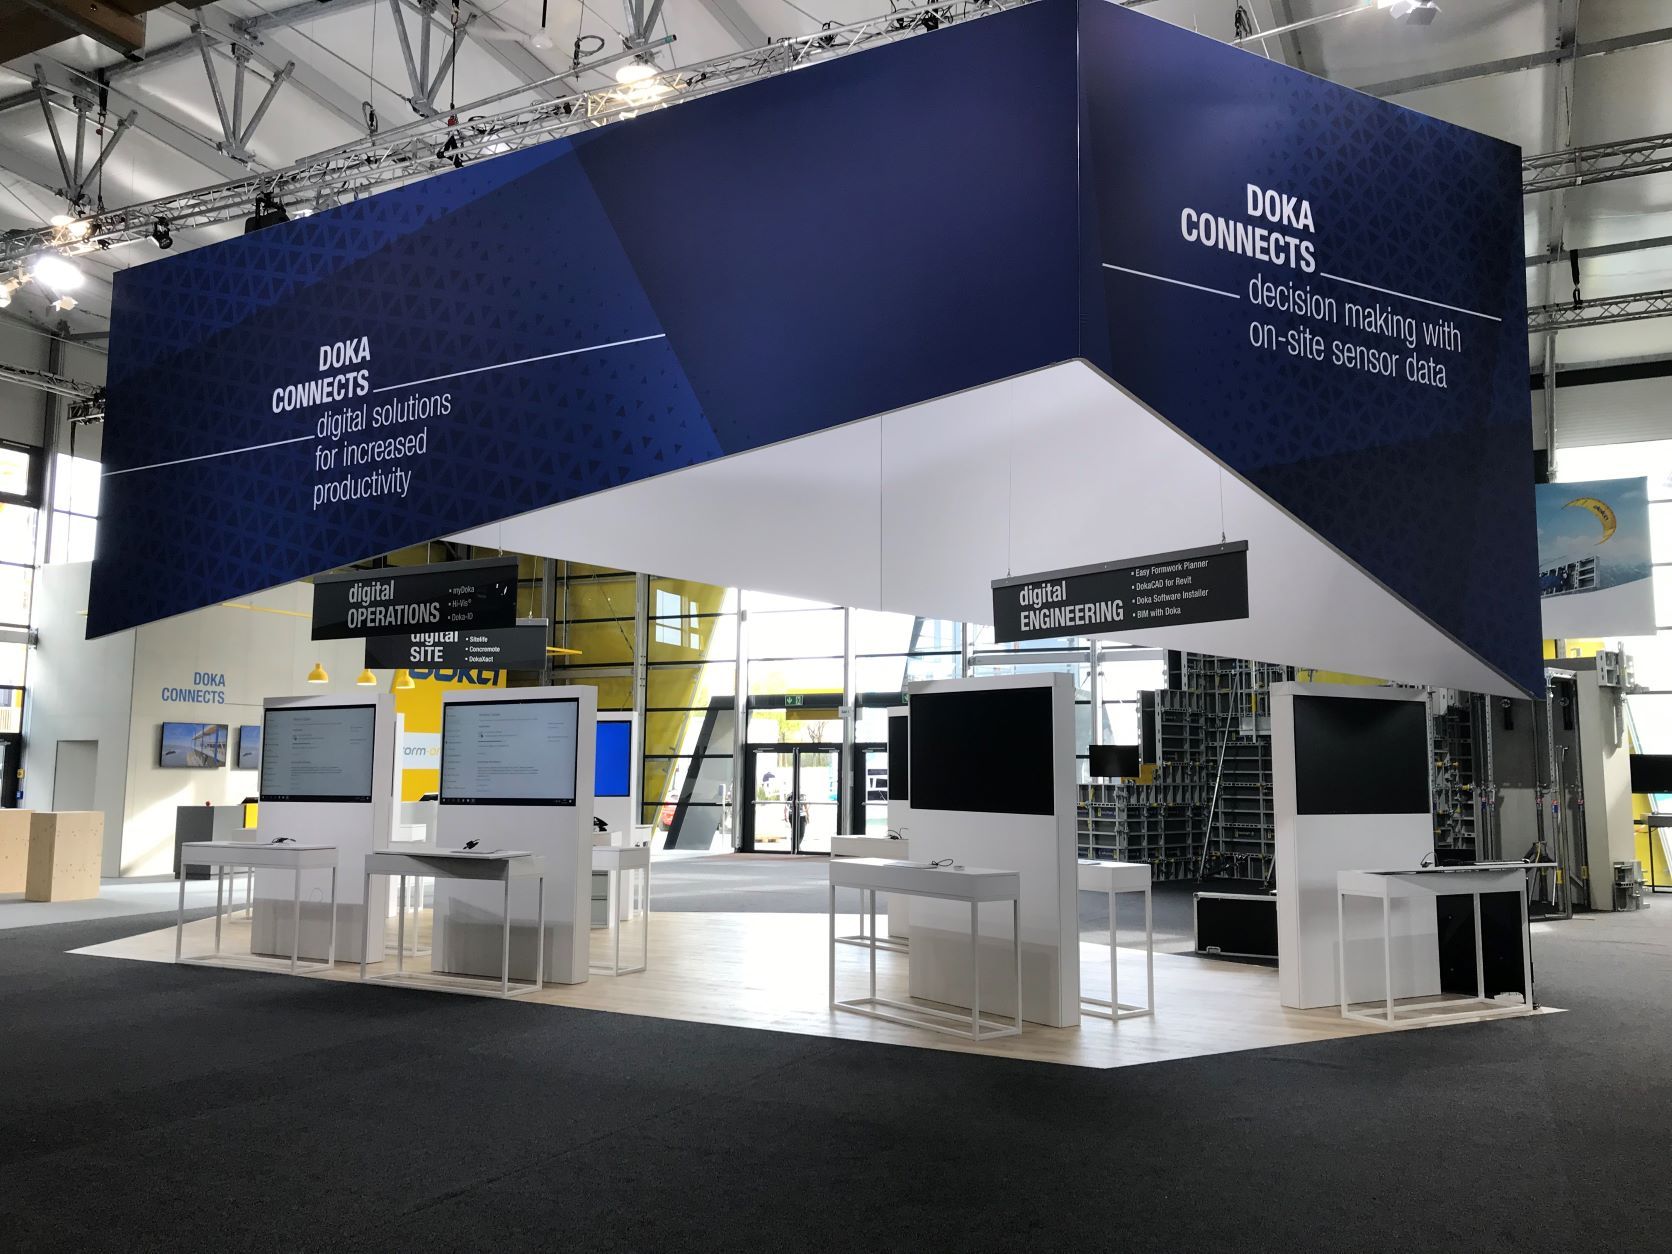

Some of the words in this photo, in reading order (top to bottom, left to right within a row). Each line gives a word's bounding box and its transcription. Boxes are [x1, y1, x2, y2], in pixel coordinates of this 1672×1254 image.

[1246, 183, 1315, 233] DOKA
[1181, 207, 1316, 273] CONNECTS
[1249, 273, 1337, 323] decision
[1345, 303, 1416, 348] making
[1423, 319, 1461, 352] with
[319, 336, 371, 371] DOKA
[1250, 321, 1325, 360] on-site
[1332, 340, 1399, 377] sensor
[1406, 352, 1448, 388] data
[272, 369, 369, 413] CONNECTS
[317, 403, 367, 440] digital
[372, 393, 451, 427] solutions
[315, 445, 338, 471] for
[343, 426, 427, 466] increased
[313, 467, 412, 510] productivity
[1135, 568, 1150, 577] Easy
[1151, 563, 1183, 575] Formwork
[1183, 560, 1209, 570] Planner
[1136, 579, 1164, 590] DokaCAD
[1165, 578, 1175, 587] for
[1175, 575, 1192, 585] Revit
[348, 579, 395, 607] digital
[452, 585, 475, 595] myDoka
[1020, 580, 1067, 608] digital
[1136, 595, 1153, 604] Doka
[1153, 592, 1181, 603] Software
[1182, 588, 1209, 599] Installer
[347, 601, 440, 629] OPERATIONS
[1020, 599, 1124, 631] ENGINEERING
[1137, 609, 1149, 618] BIM
[1150, 608, 1164, 617] with
[1165, 606, 1182, 615] Doka
[409, 646, 444, 662] SITE
[193, 671, 226, 687] DOKA
[161, 687, 225, 704] CONNECTS
